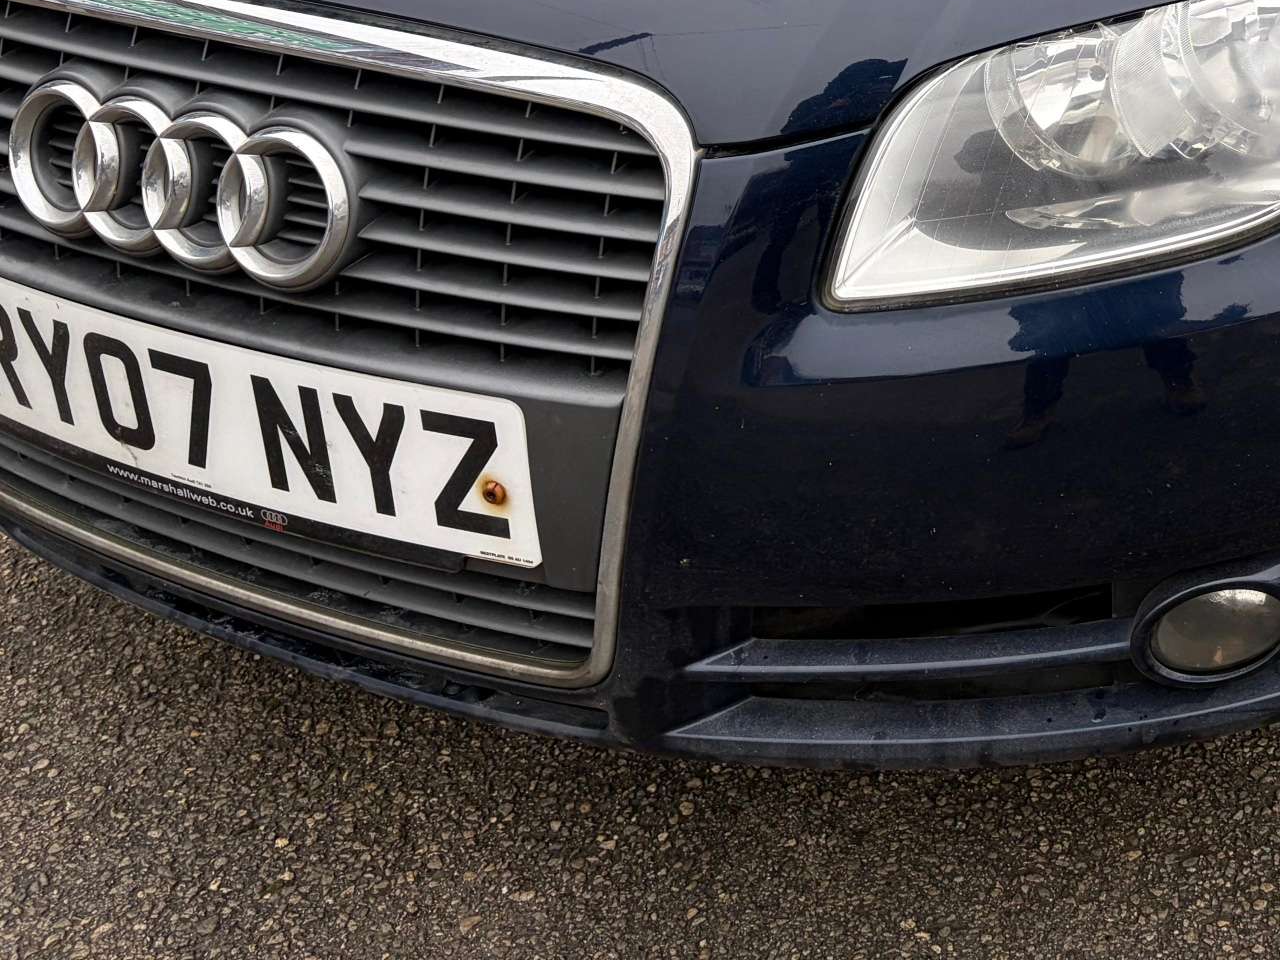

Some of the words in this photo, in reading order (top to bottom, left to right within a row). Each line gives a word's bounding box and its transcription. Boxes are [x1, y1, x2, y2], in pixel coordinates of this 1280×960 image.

[0, 307, 212, 469] RY07
[250, 375, 511, 539] NYZ
[107, 464, 255, 519] www.marshallweb.co.uk
[263, 520, 284, 533] Audi
